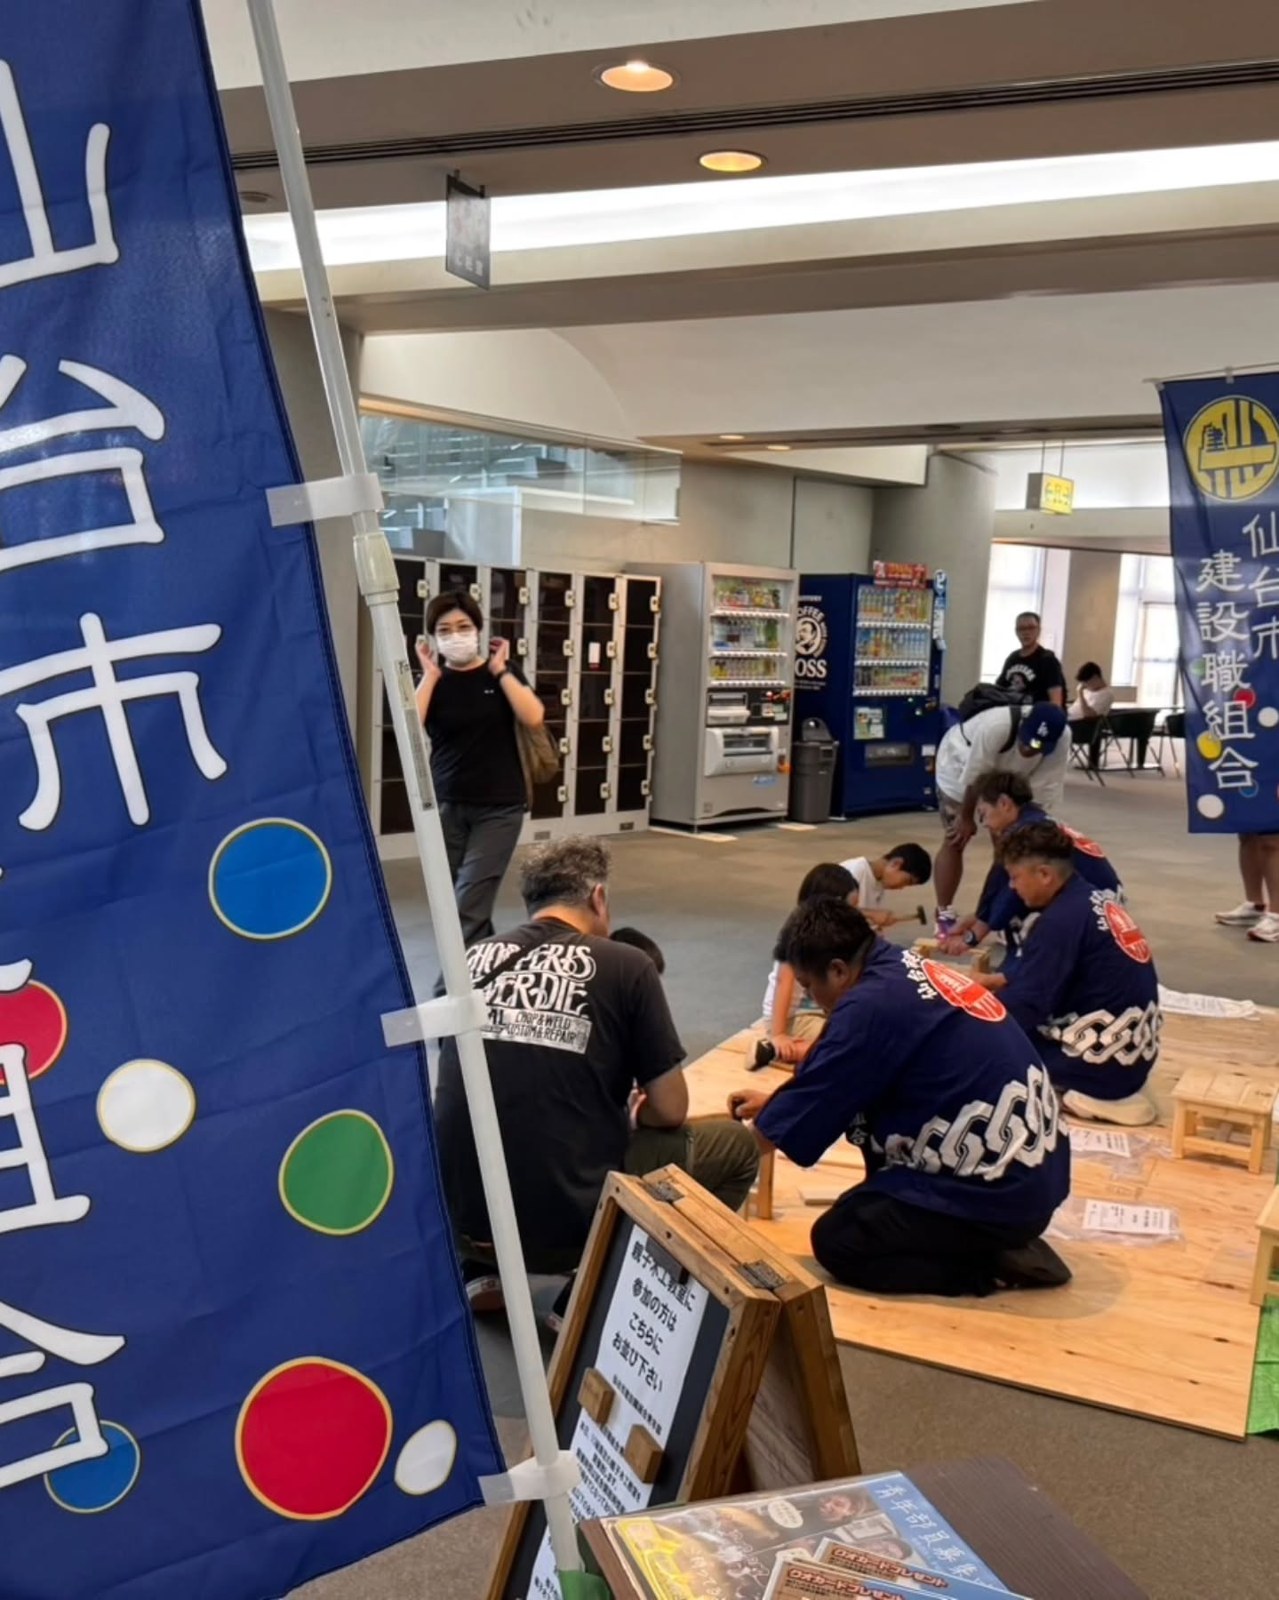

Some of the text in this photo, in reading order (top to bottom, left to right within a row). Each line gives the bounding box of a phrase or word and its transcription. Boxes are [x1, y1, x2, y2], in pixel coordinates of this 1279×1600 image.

[795, 658, 828, 679] OSS
[1195, 548, 1259, 790] 建設職組合
[632, 1277, 678, 1332] 参加の方は
[629, 1312, 664, 1356] こちらに
[612, 1331, 663, 1393] お並び下さい
